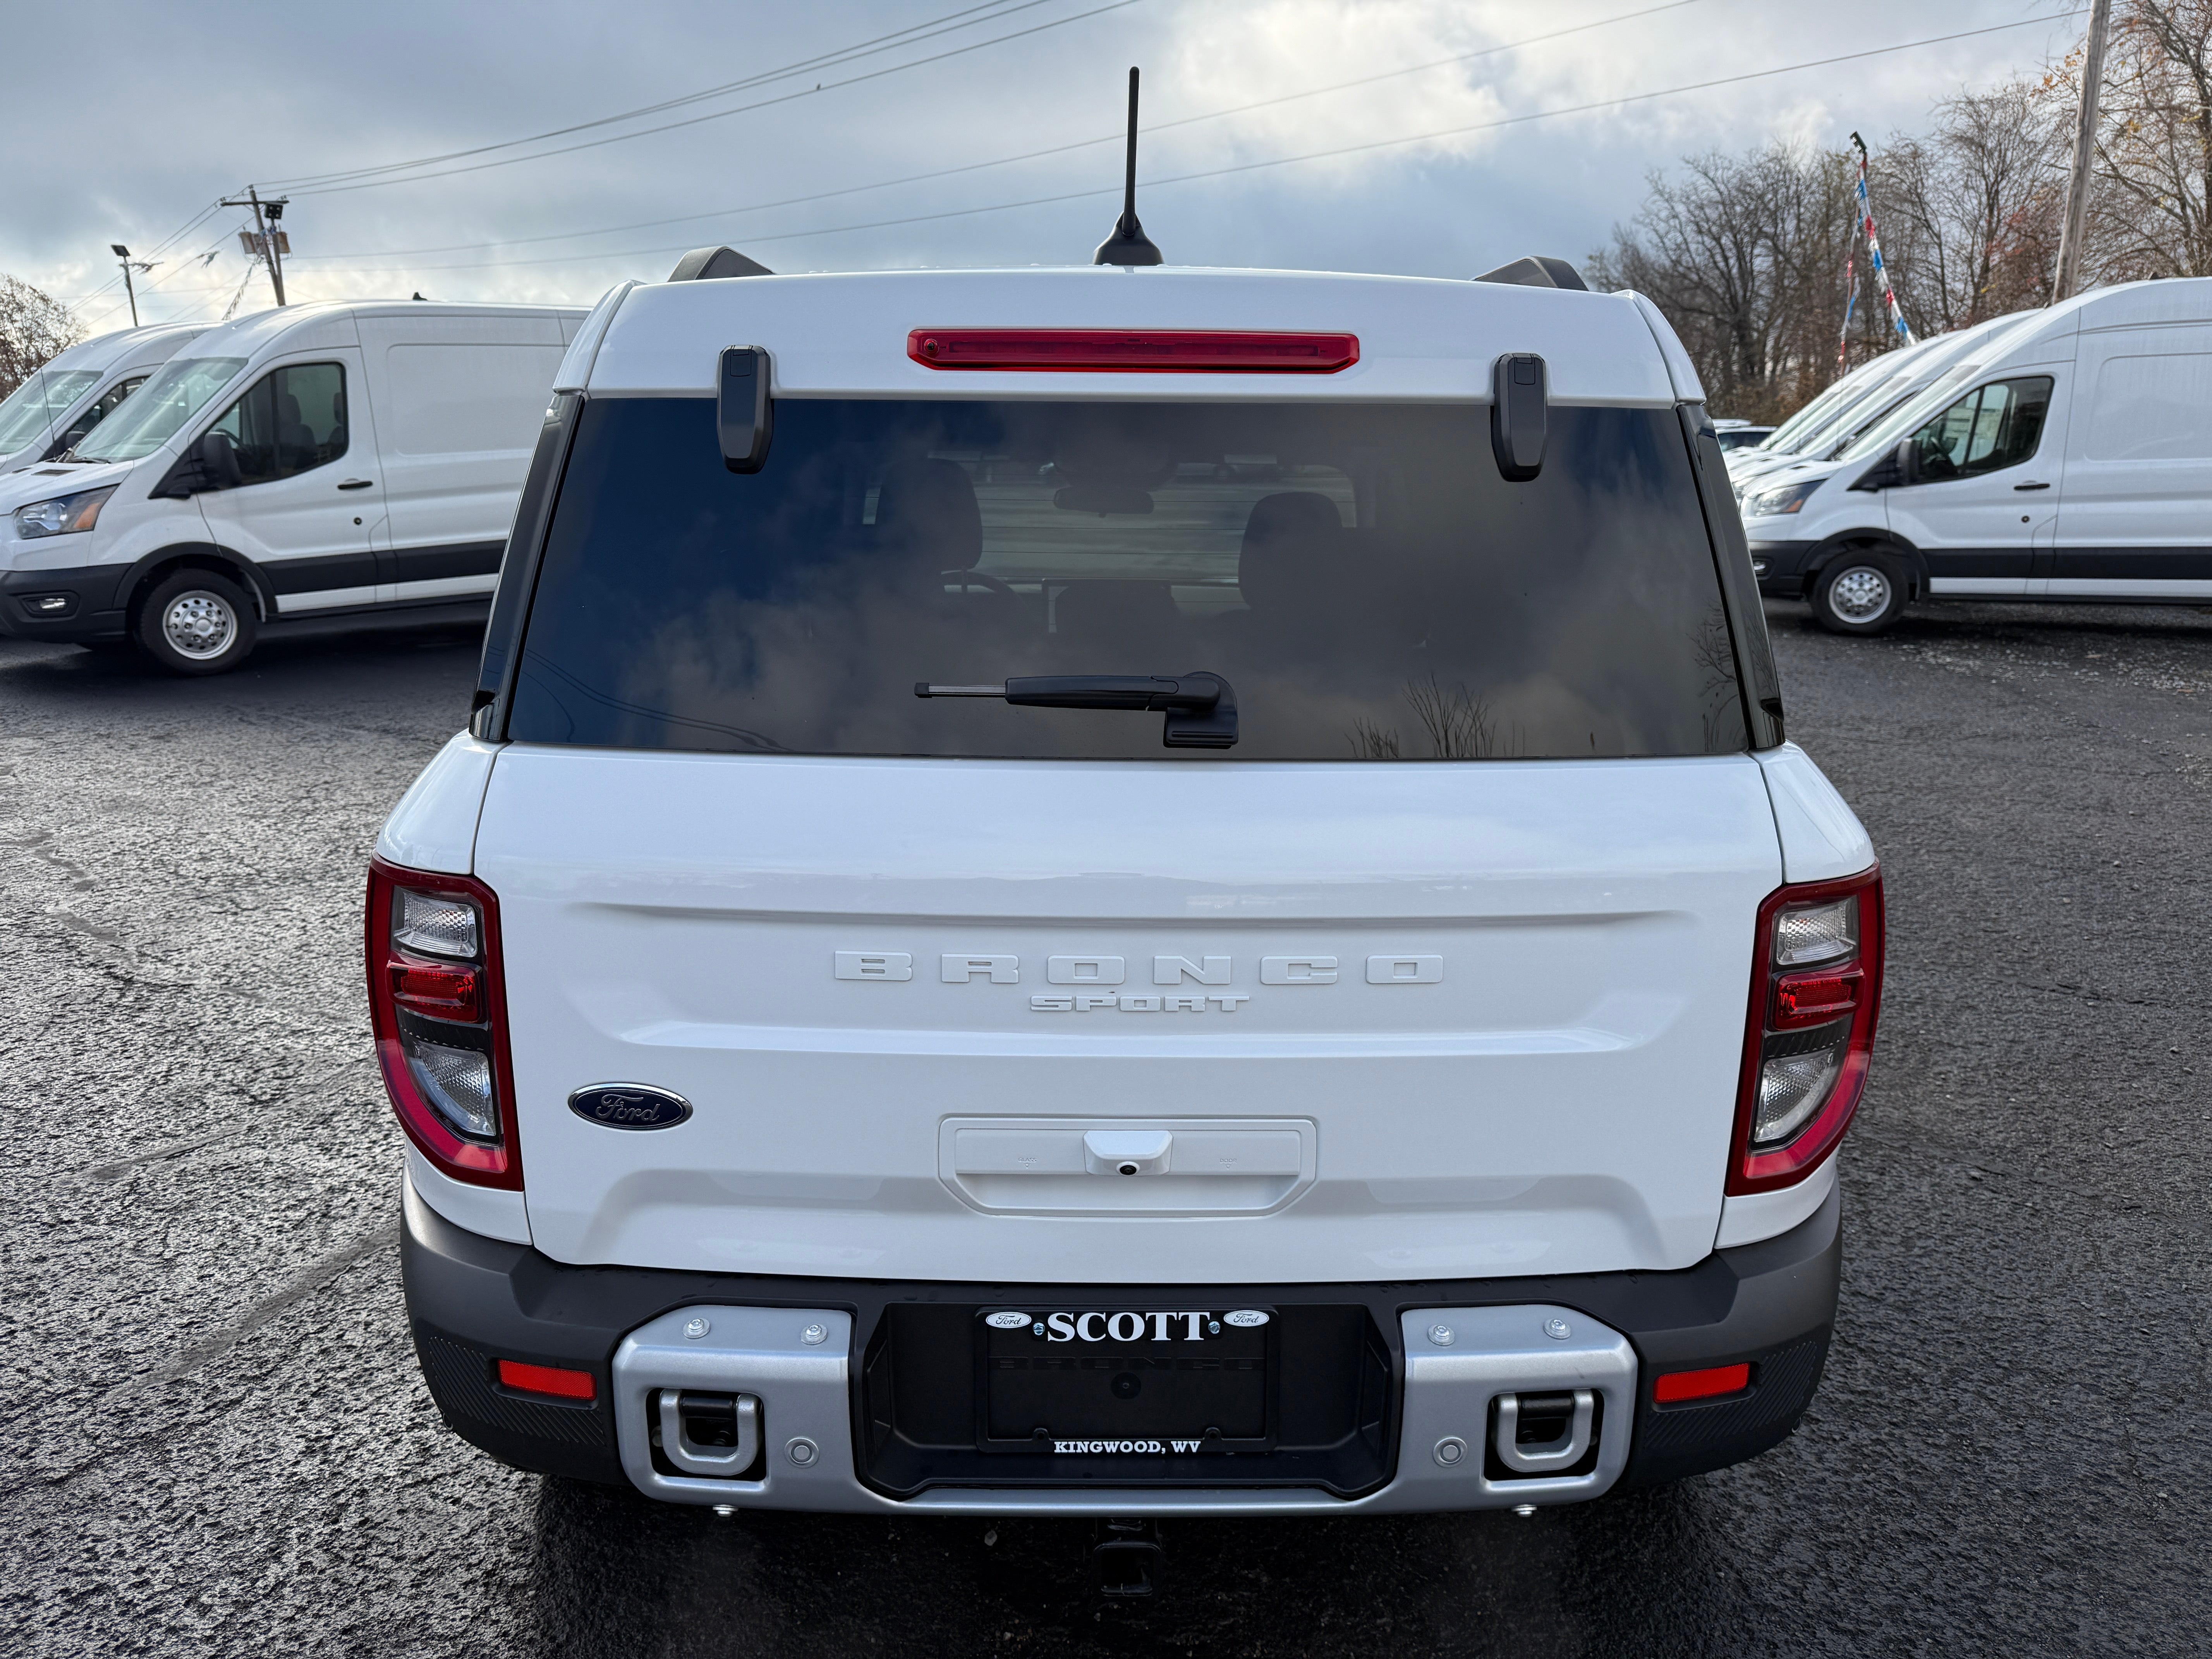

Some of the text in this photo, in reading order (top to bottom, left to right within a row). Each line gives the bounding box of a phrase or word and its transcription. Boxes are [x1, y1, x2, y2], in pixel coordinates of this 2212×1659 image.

[835, 951, 1443, 985] BRONCO
[1031, 996, 1249, 1011] SPORT
[595, 1094, 660, 1121] Ford
[996, 1312, 1259, 1341] Ford SCOTT Ford
[988, 1356, 1265, 1370] BRONCO
[1054, 1441, 1201, 1454] KINGWOOD, WV
